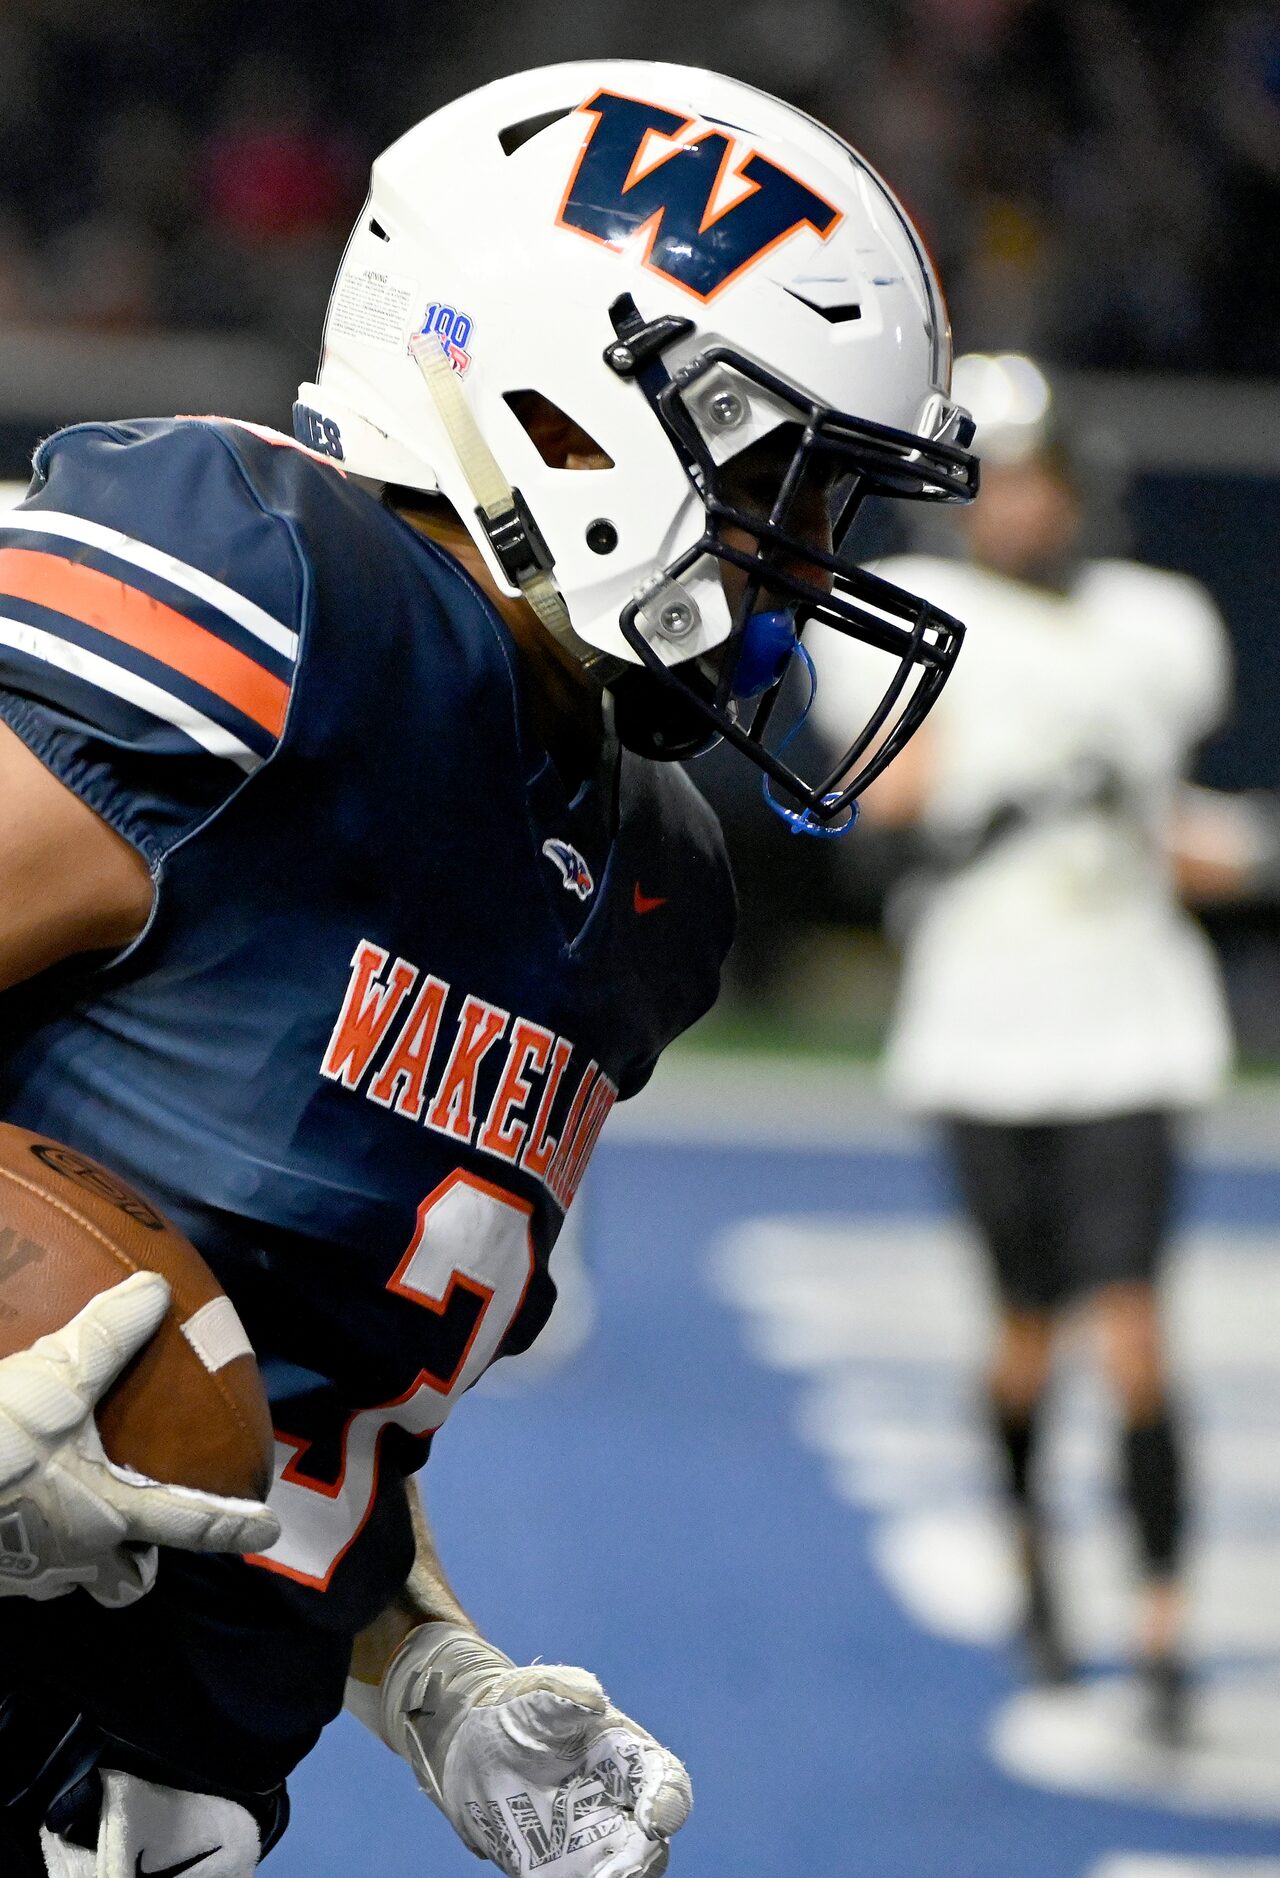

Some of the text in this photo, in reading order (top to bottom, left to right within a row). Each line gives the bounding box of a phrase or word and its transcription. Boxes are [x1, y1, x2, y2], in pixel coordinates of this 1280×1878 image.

[554, 88, 844, 305] W
[421, 305, 472, 350] 100
[242, 1166, 535, 1593] 3
